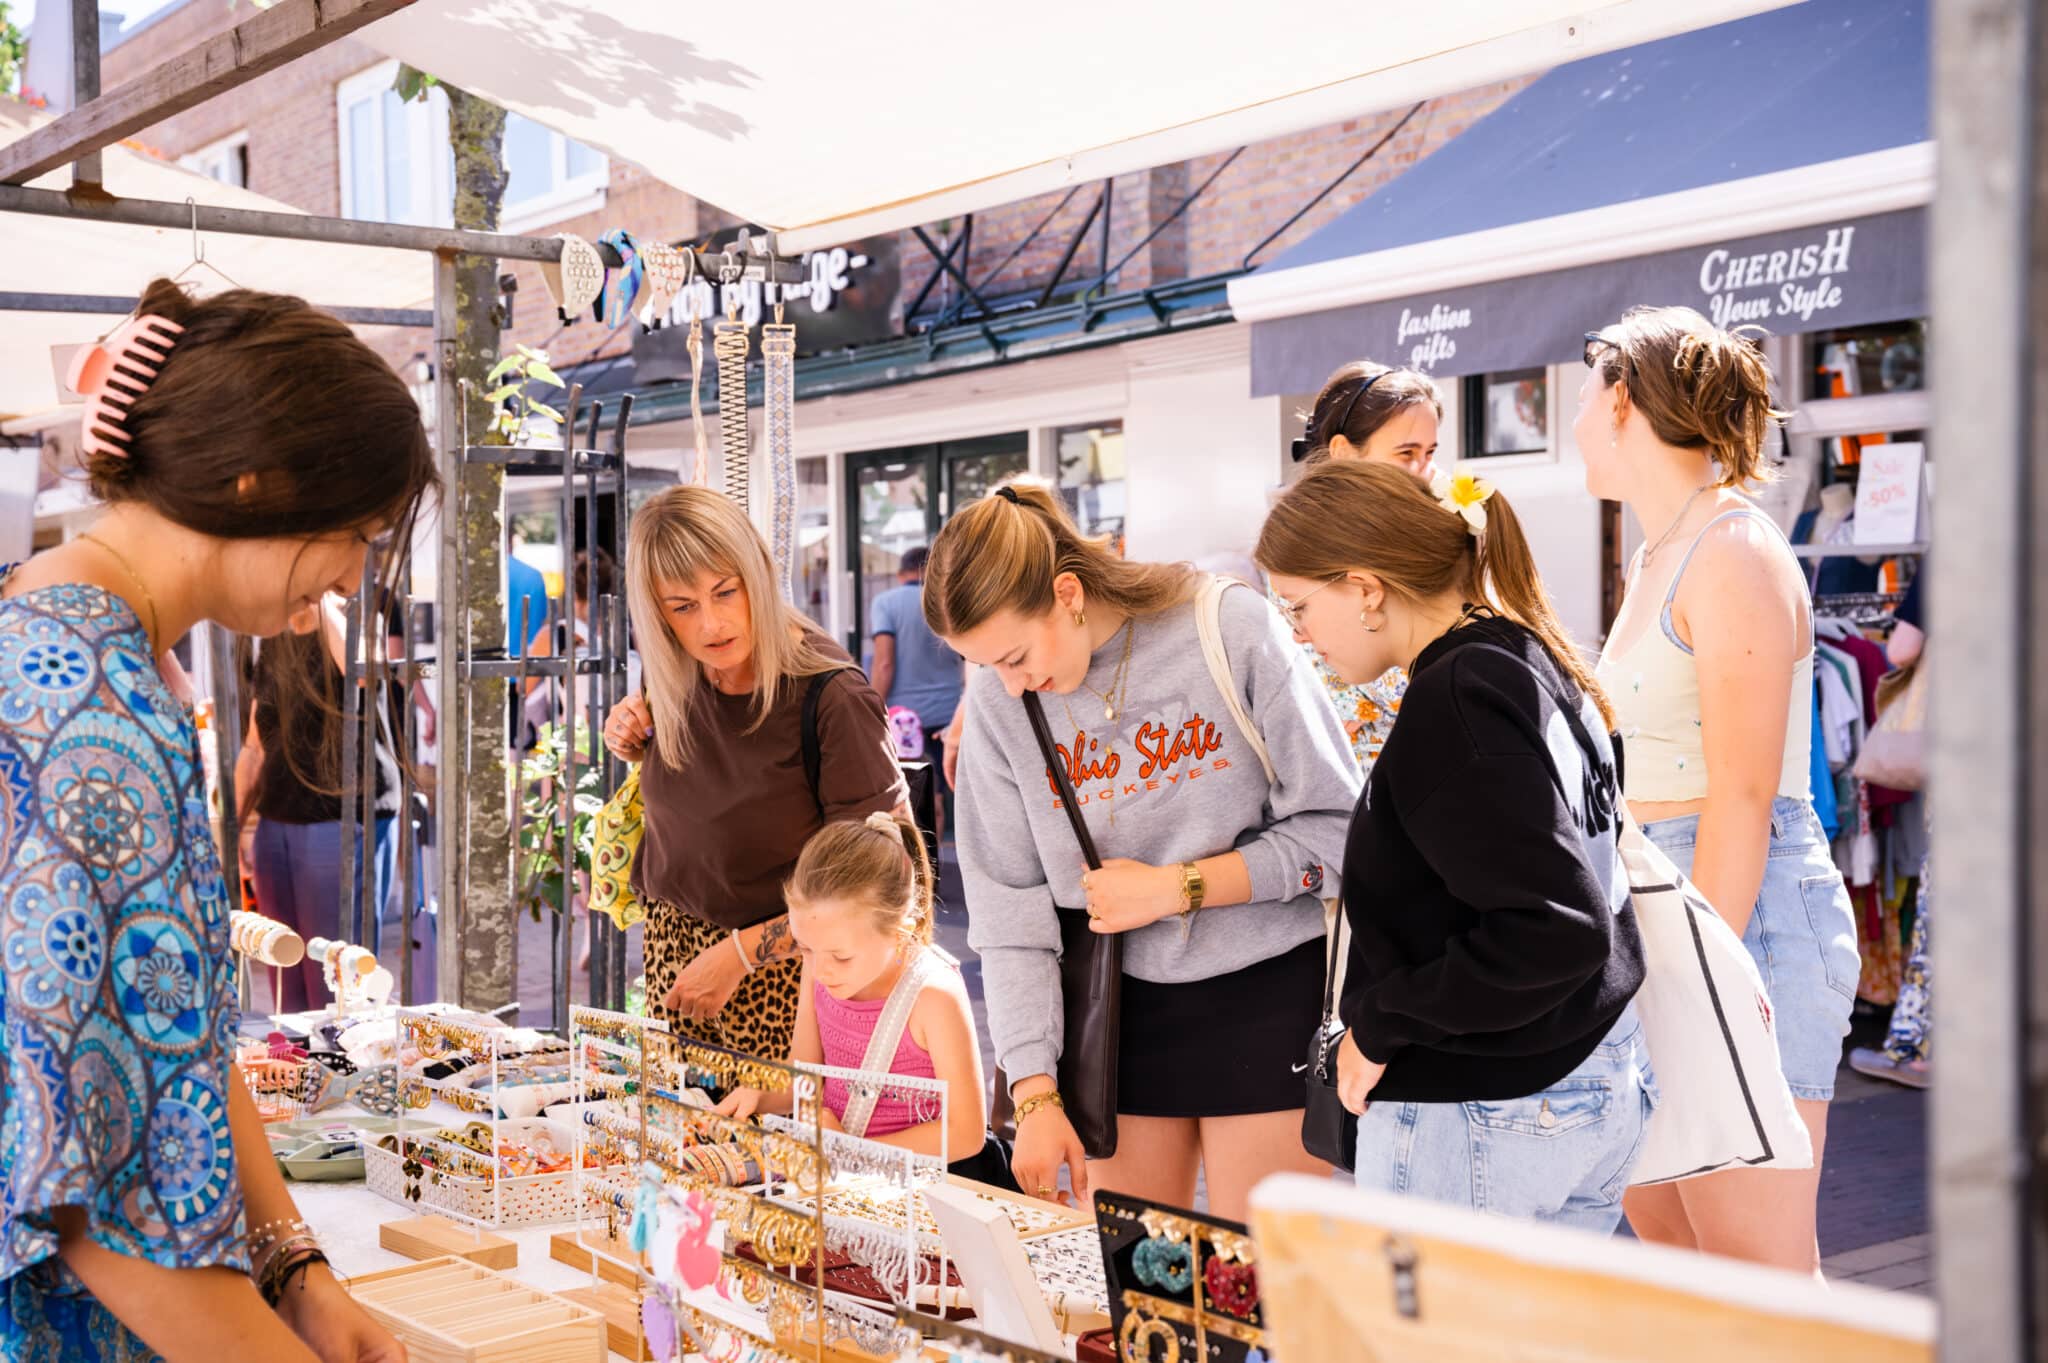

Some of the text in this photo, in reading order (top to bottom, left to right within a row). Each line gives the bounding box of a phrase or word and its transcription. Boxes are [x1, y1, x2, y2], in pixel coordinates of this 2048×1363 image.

[1700, 226, 1855, 294] CHERISH
[1397, 303, 1471, 346] fashion
[1709, 276, 1842, 330] Your Style
[1411, 331, 1456, 371] gifts
[1135, 712, 1222, 780] State
